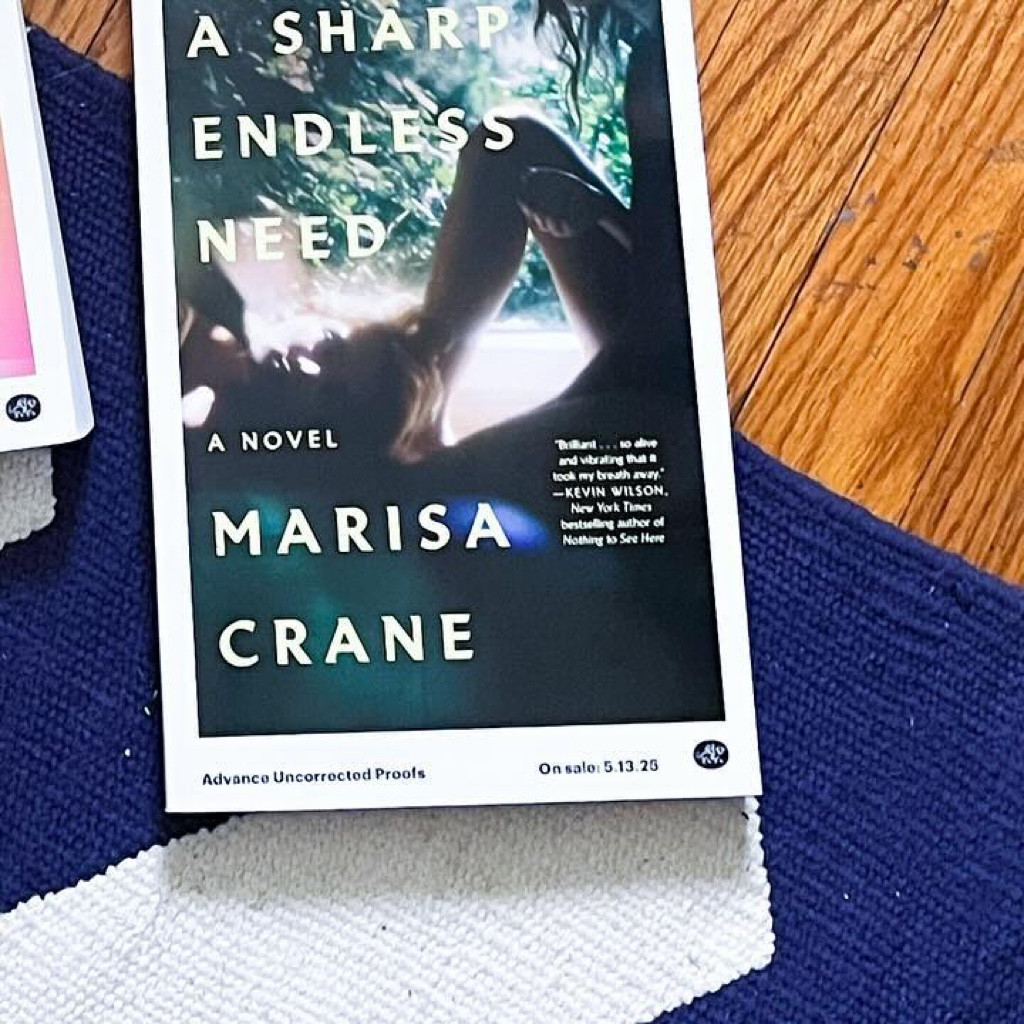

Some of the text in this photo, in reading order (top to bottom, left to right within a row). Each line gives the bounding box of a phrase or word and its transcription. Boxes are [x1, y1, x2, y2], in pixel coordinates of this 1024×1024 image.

[186, 5, 510, 58] A SHARP
[191, 107, 516, 160] ENDLESS
[197, 215, 386, 263] NEED
[208, 429, 338, 452] A NOVEL
[619, 440, 632, 449] so
[634, 438, 658, 448] alive
[559, 455, 578, 465] and
[579, 454, 624, 466] vibrating
[626, 454, 647, 464] that
[552, 471, 576, 482] took
[579, 472, 594, 482] my
[596, 470, 630, 480] breath
[571, 501, 652, 514] New York Times
[212, 501, 511, 557] MARISA
[560, 516, 665, 531] bestselling author of
[563, 532, 665, 546] Nothing to See Here
[219, 612, 475, 668] CRANE
[539, 759, 659, 774] On sale: 5.13.25
[202, 766, 426, 786] Advance Uncorrected Proofs
